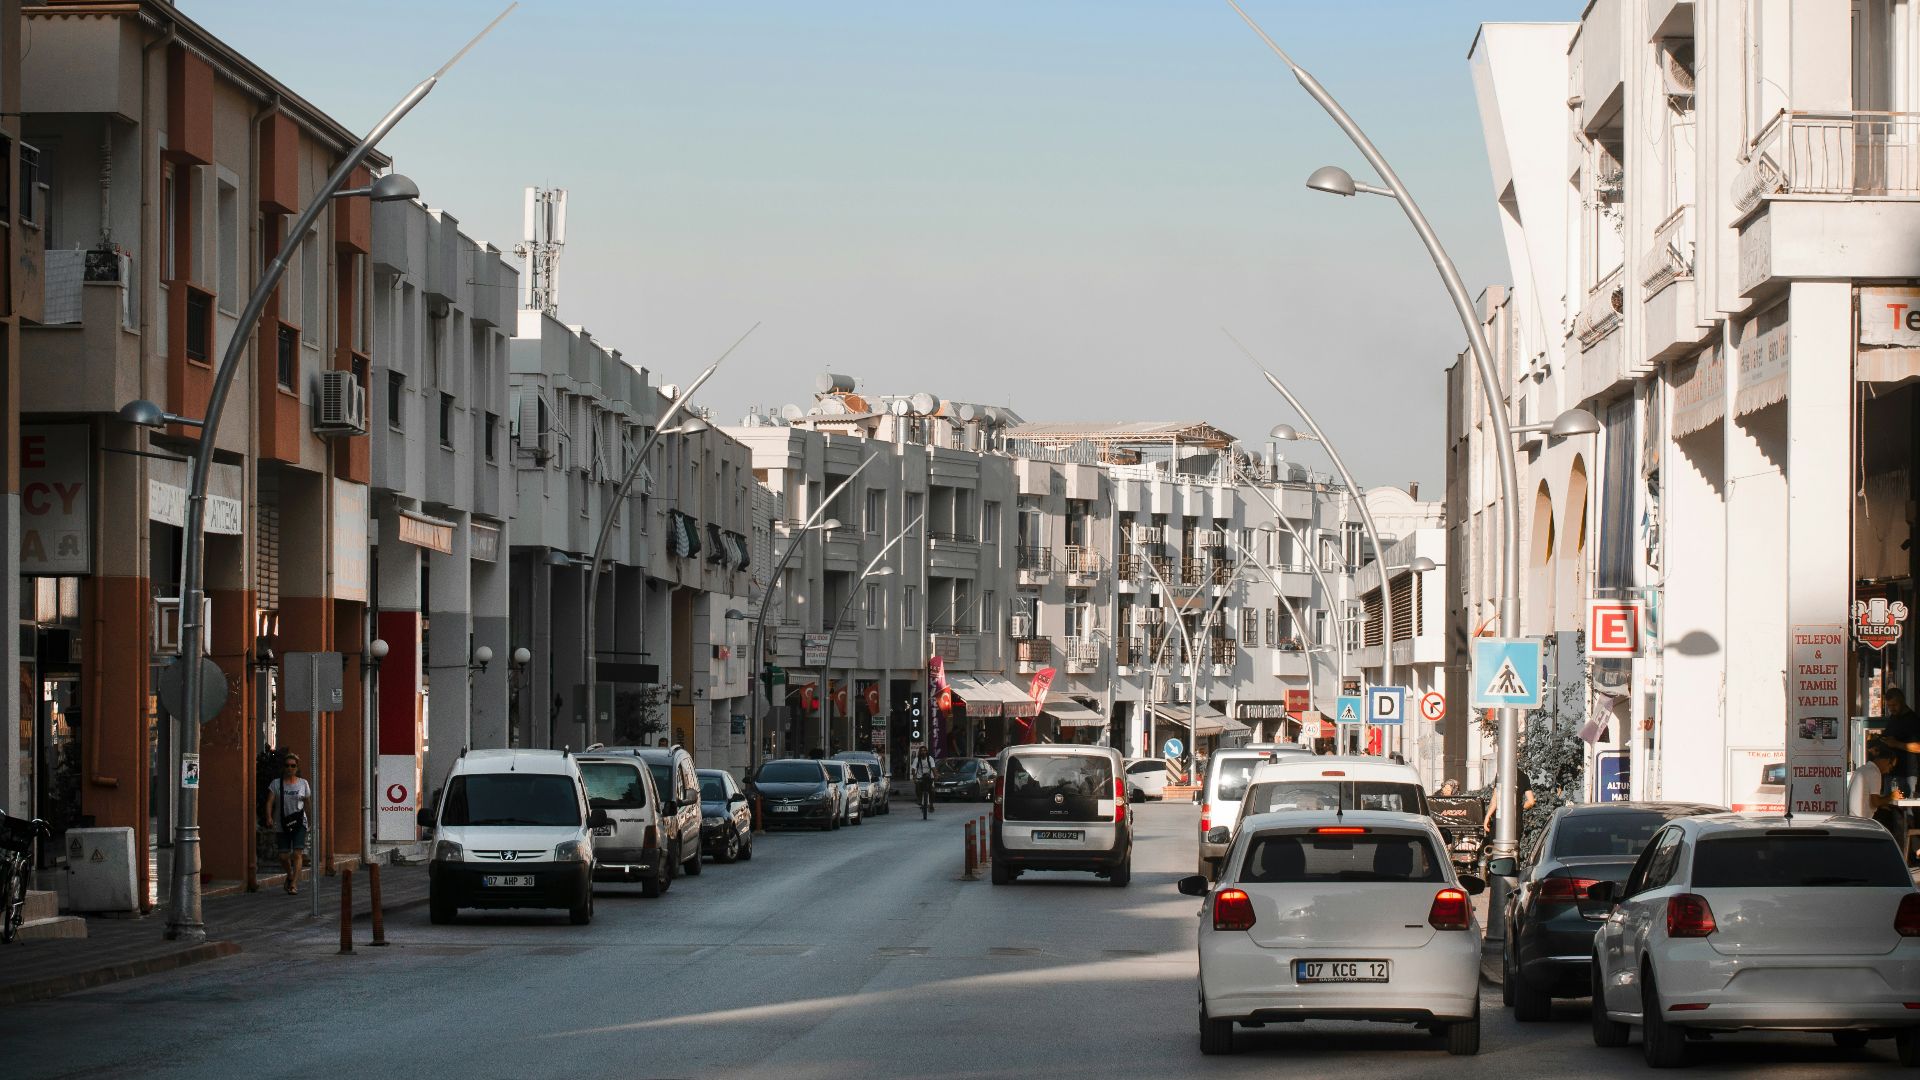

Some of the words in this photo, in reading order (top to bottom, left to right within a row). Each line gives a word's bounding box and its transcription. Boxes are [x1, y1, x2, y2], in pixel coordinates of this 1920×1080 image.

[1887, 304, 1920, 332] Te
[1602, 614, 1628, 643] E
[1858, 626, 1898, 635] TELEFON
[1795, 635, 1841, 645] TELEFON
[1814, 650, 1822, 659] &
[1799, 665, 1839, 675] TABLET
[1800, 678, 1838, 690] TAMİRİ
[1379, 696, 1395, 716] D
[1798, 696, 1839, 706] YAPILIR
[912, 698, 920, 739] FOTO
[1793, 767, 1842, 777] TELEPHONE
[1814, 784, 1821, 795] &
[1797, 801, 1838, 812] TABLET
[488, 876, 498, 886] 07
[504, 876, 519, 886] AHP
[523, 876, 533, 886] 30
[1307, 963, 1324, 977] 07
[1332, 963, 1357, 977] KCG
[1369, 963, 1385, 977] 12
